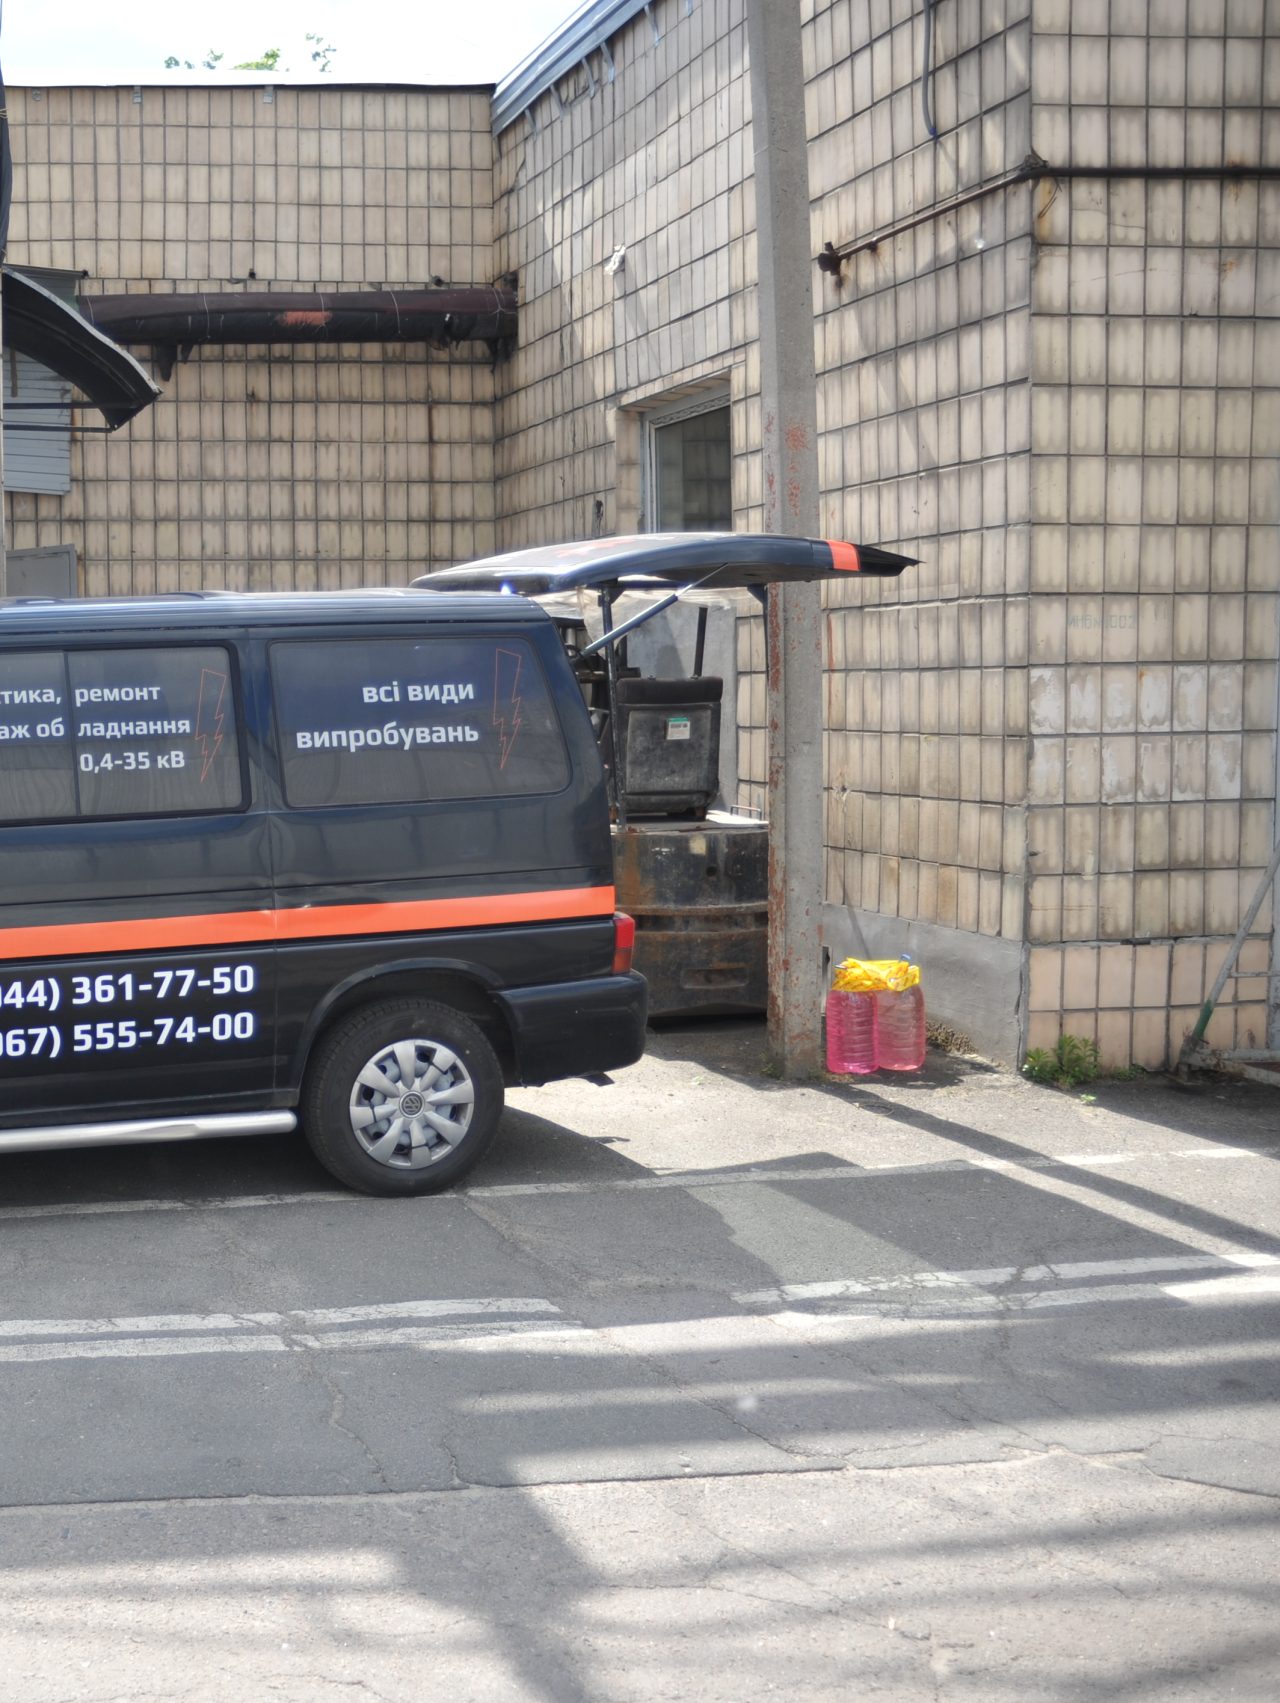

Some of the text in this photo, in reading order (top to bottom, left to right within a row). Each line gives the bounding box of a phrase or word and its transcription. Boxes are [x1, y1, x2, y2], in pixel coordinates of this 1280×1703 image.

[74, 685, 161, 708] ремонт
[362, 681, 474, 706] всі види
[296, 722, 479, 751] випробувань
[79, 750, 186, 775] 0,4-35 кВ
[72, 964, 255, 1006] 361-77-50
[73, 1011, 255, 1053] 555-74-00
